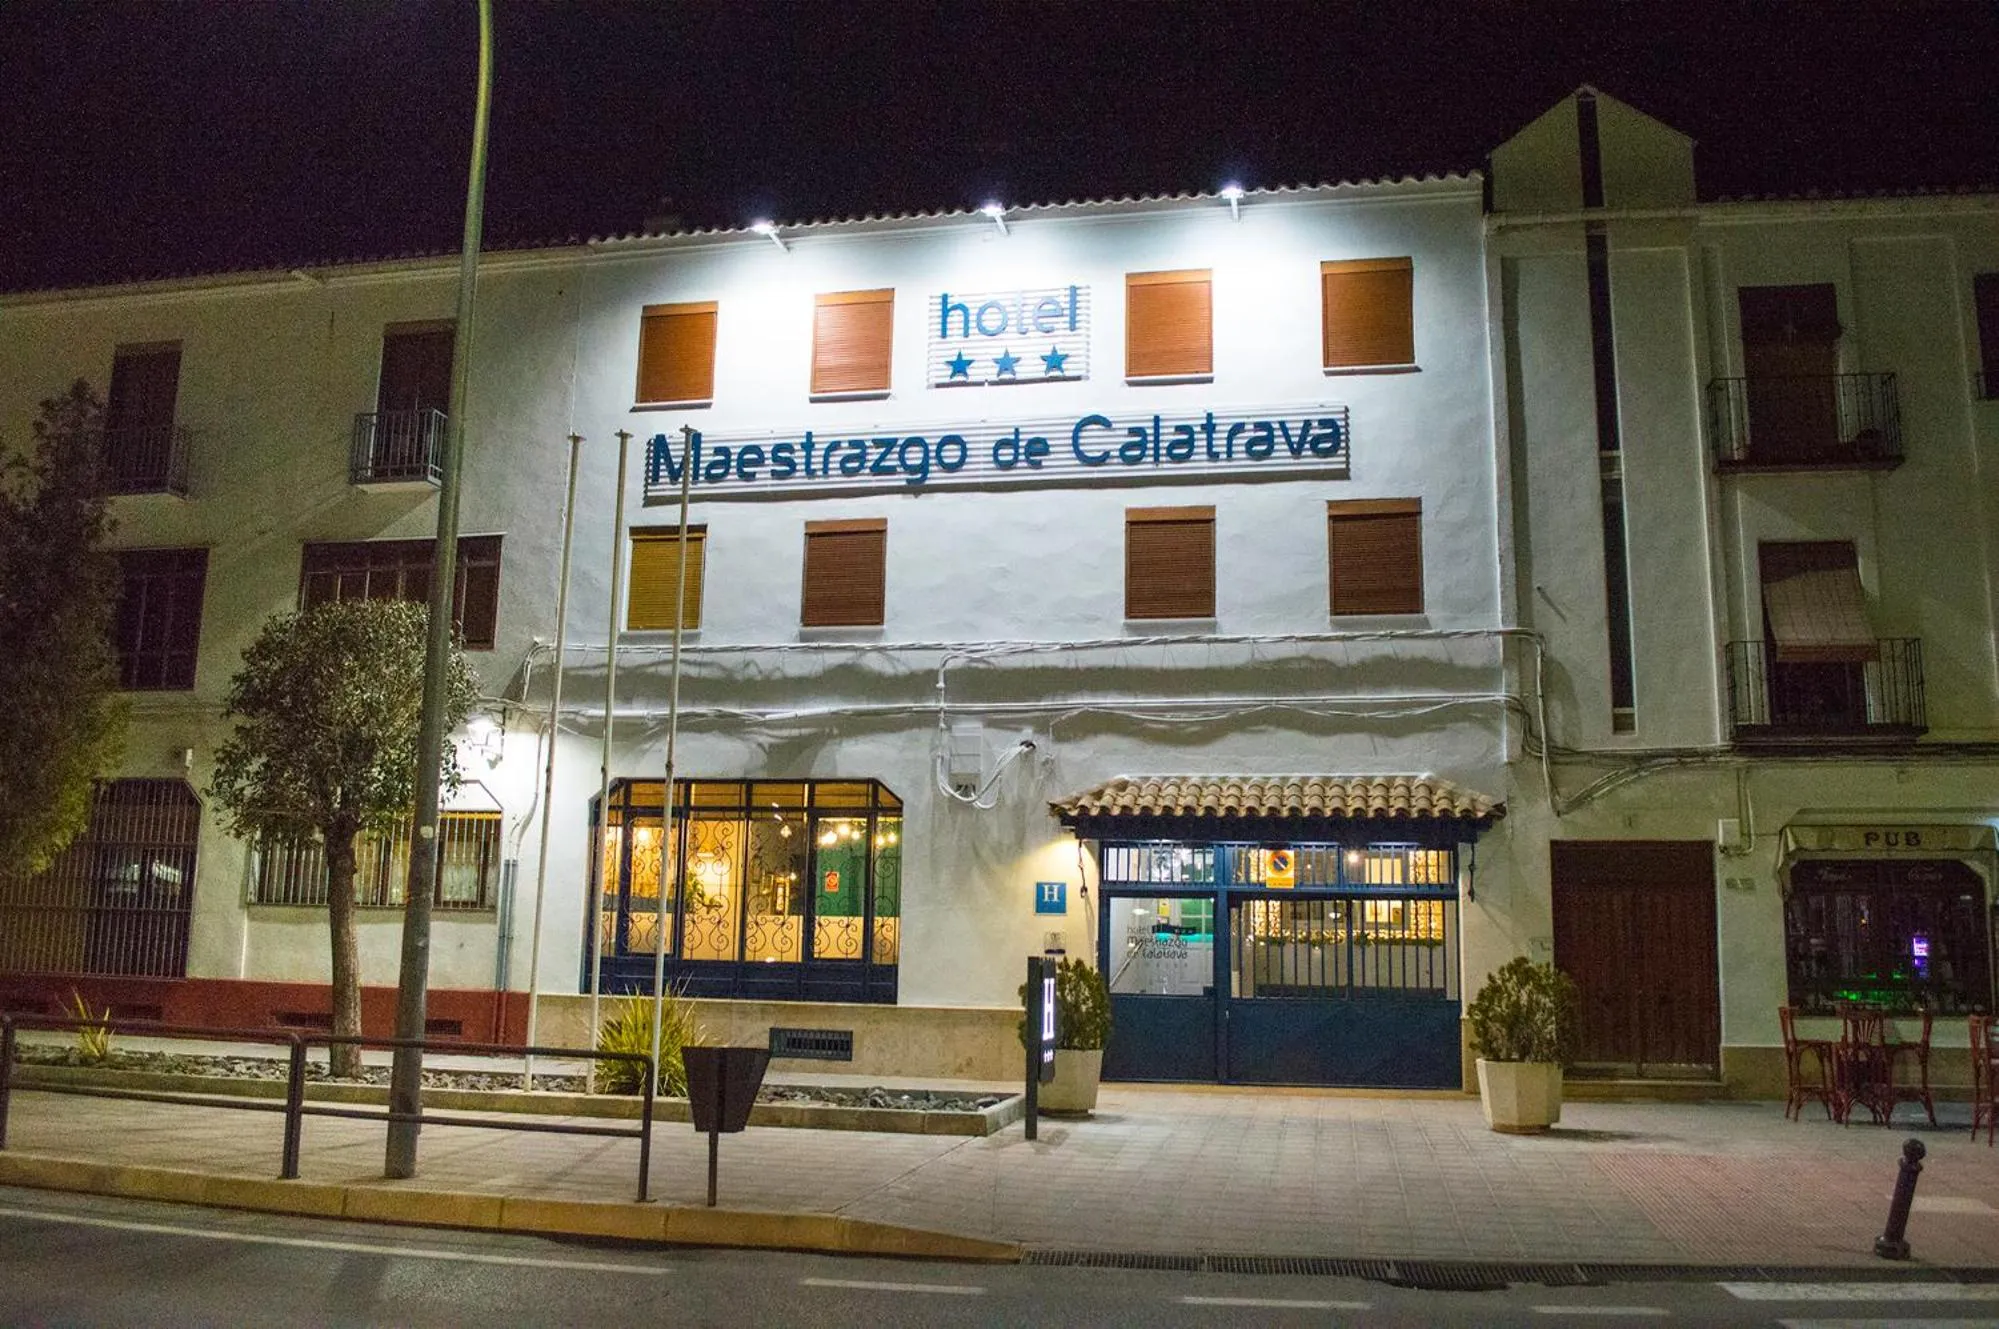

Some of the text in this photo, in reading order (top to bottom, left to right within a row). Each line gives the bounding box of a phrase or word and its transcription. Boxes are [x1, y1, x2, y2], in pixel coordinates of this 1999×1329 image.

[940, 284, 1076, 338] hotel
[651, 412, 1341, 485] Maestrazgo de Calatrava
[1863, 832, 1921, 847] PUB
[1043, 885, 1060, 902] H
